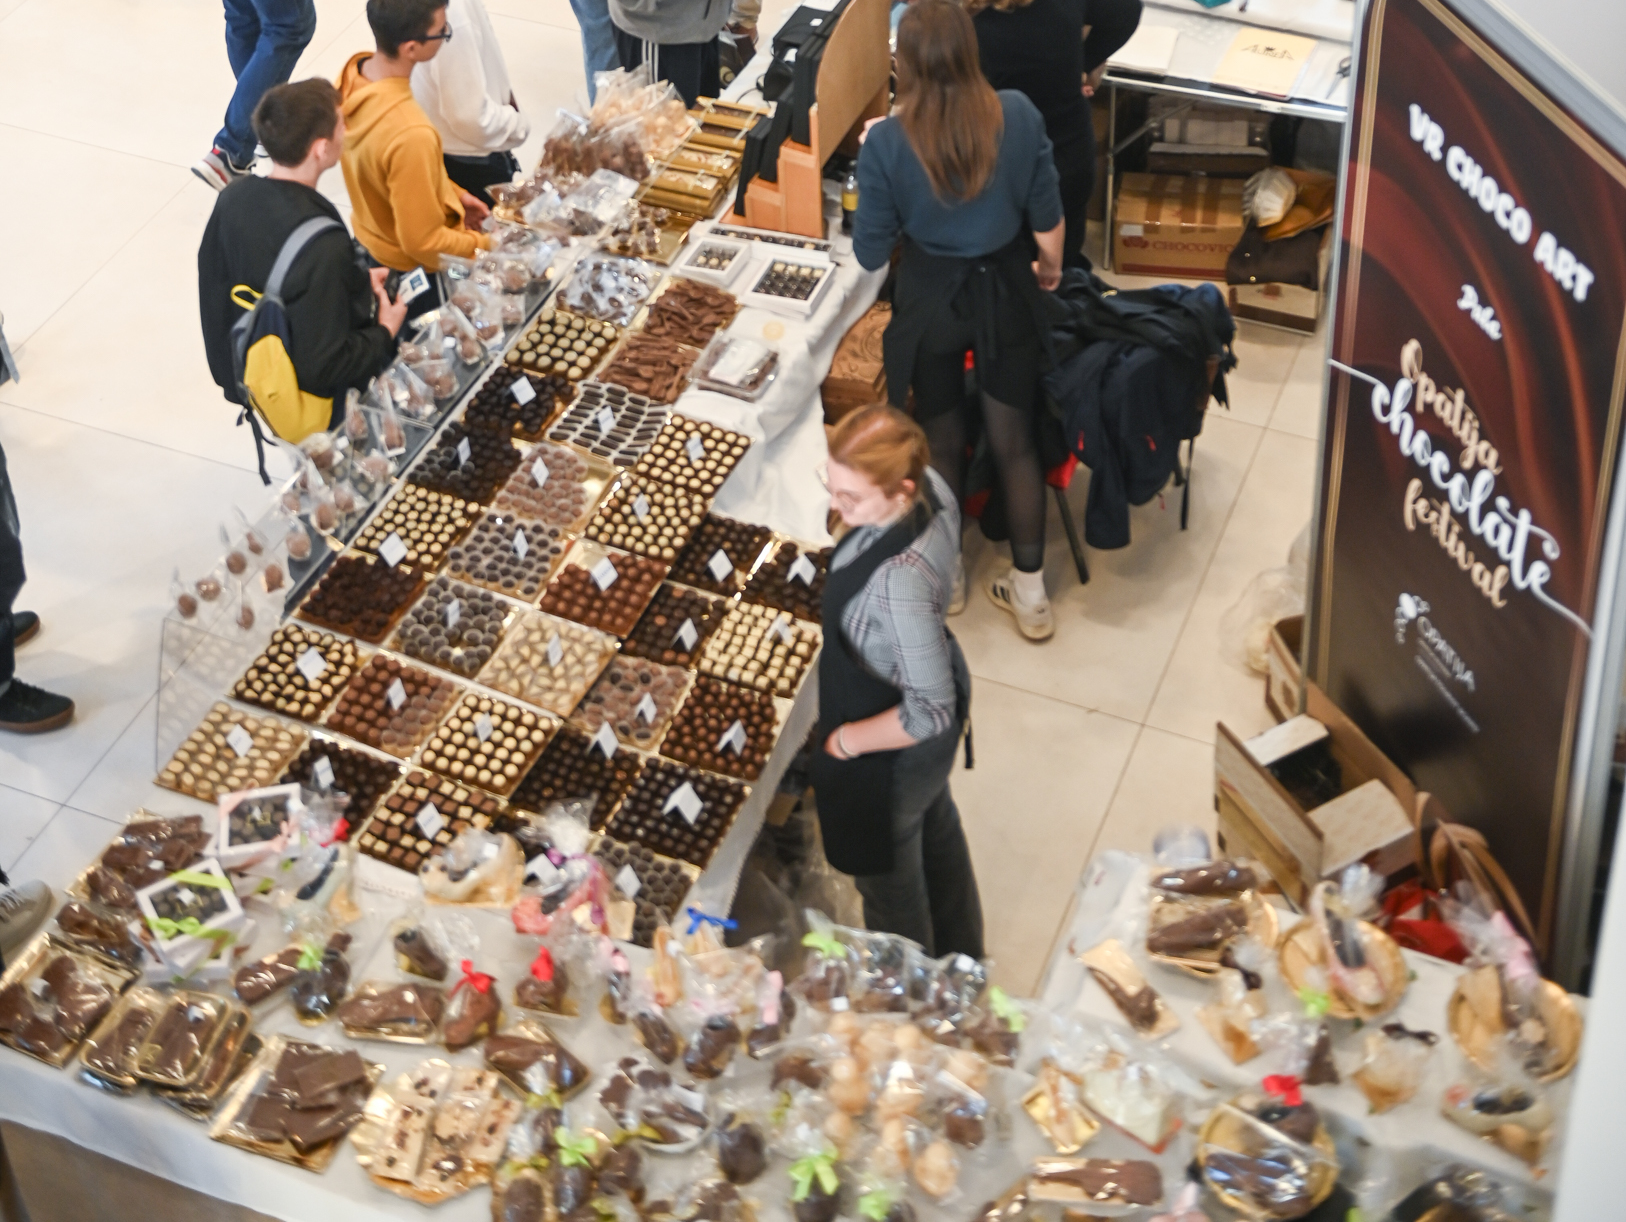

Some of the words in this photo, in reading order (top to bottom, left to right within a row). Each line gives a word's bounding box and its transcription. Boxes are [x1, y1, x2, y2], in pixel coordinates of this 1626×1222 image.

[1409, 103, 1445, 162] VR
[1446, 145, 1532, 245] CHOCO
[1533, 231, 1595, 303] ART
[1371, 378, 1561, 590] chocolate
[1401, 338, 1503, 475] Opatija
[1403, 478, 1510, 608] festival
